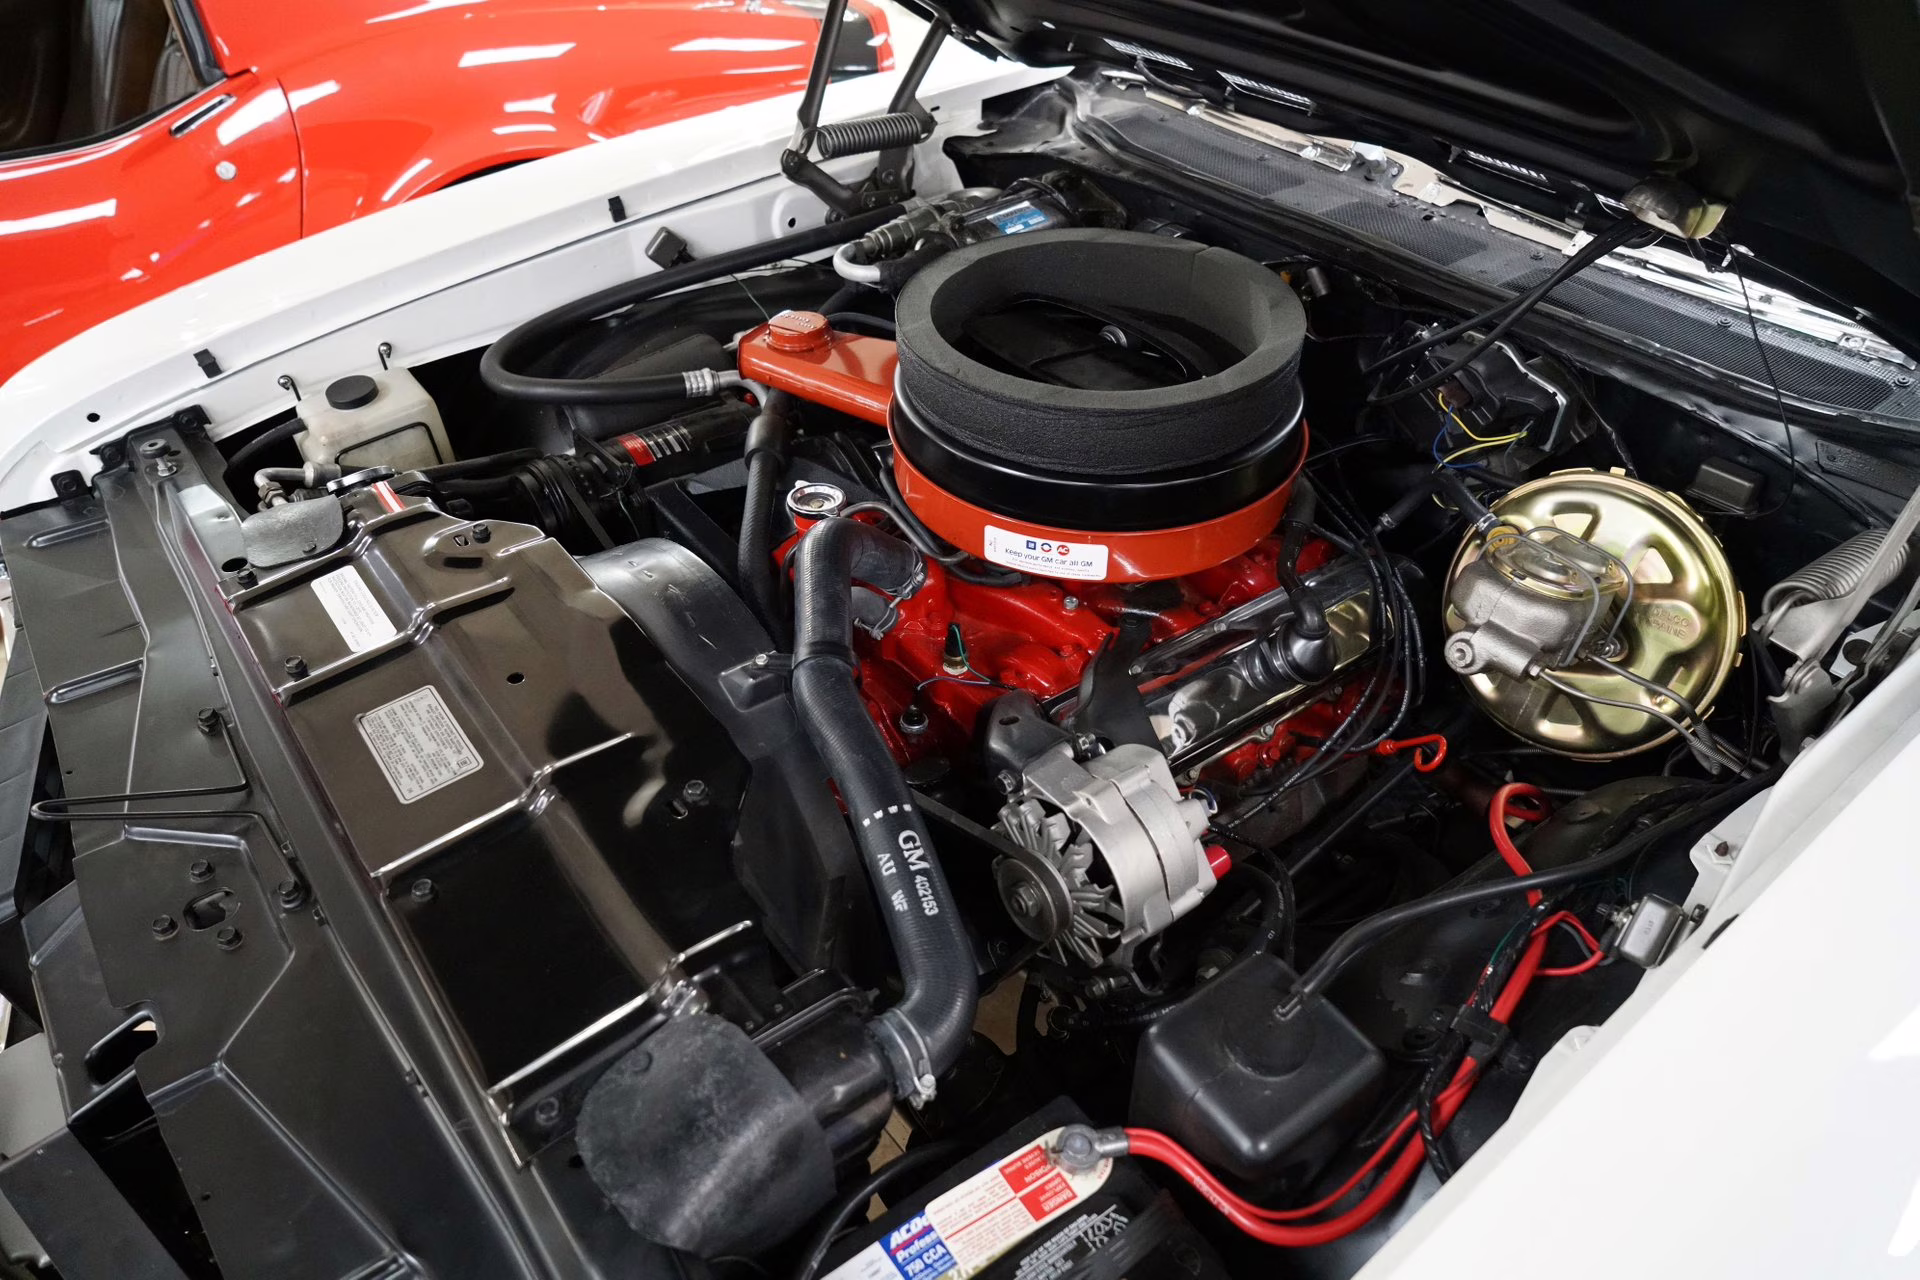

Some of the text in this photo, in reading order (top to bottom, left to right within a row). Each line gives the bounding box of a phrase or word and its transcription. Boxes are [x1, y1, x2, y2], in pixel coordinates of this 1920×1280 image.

[1005, 548, 1023, 558] Keep
[1023, 553, 1040, 562] your
[1041, 556, 1054, 564] GM
[877, 853, 897, 877] AU
[898, 829, 940, 916] GM 402153
[1041, 1188, 1073, 1213] DANGER
[904, 1258, 925, 1278] 750
[922, 1244, 947, 1264] CCA
